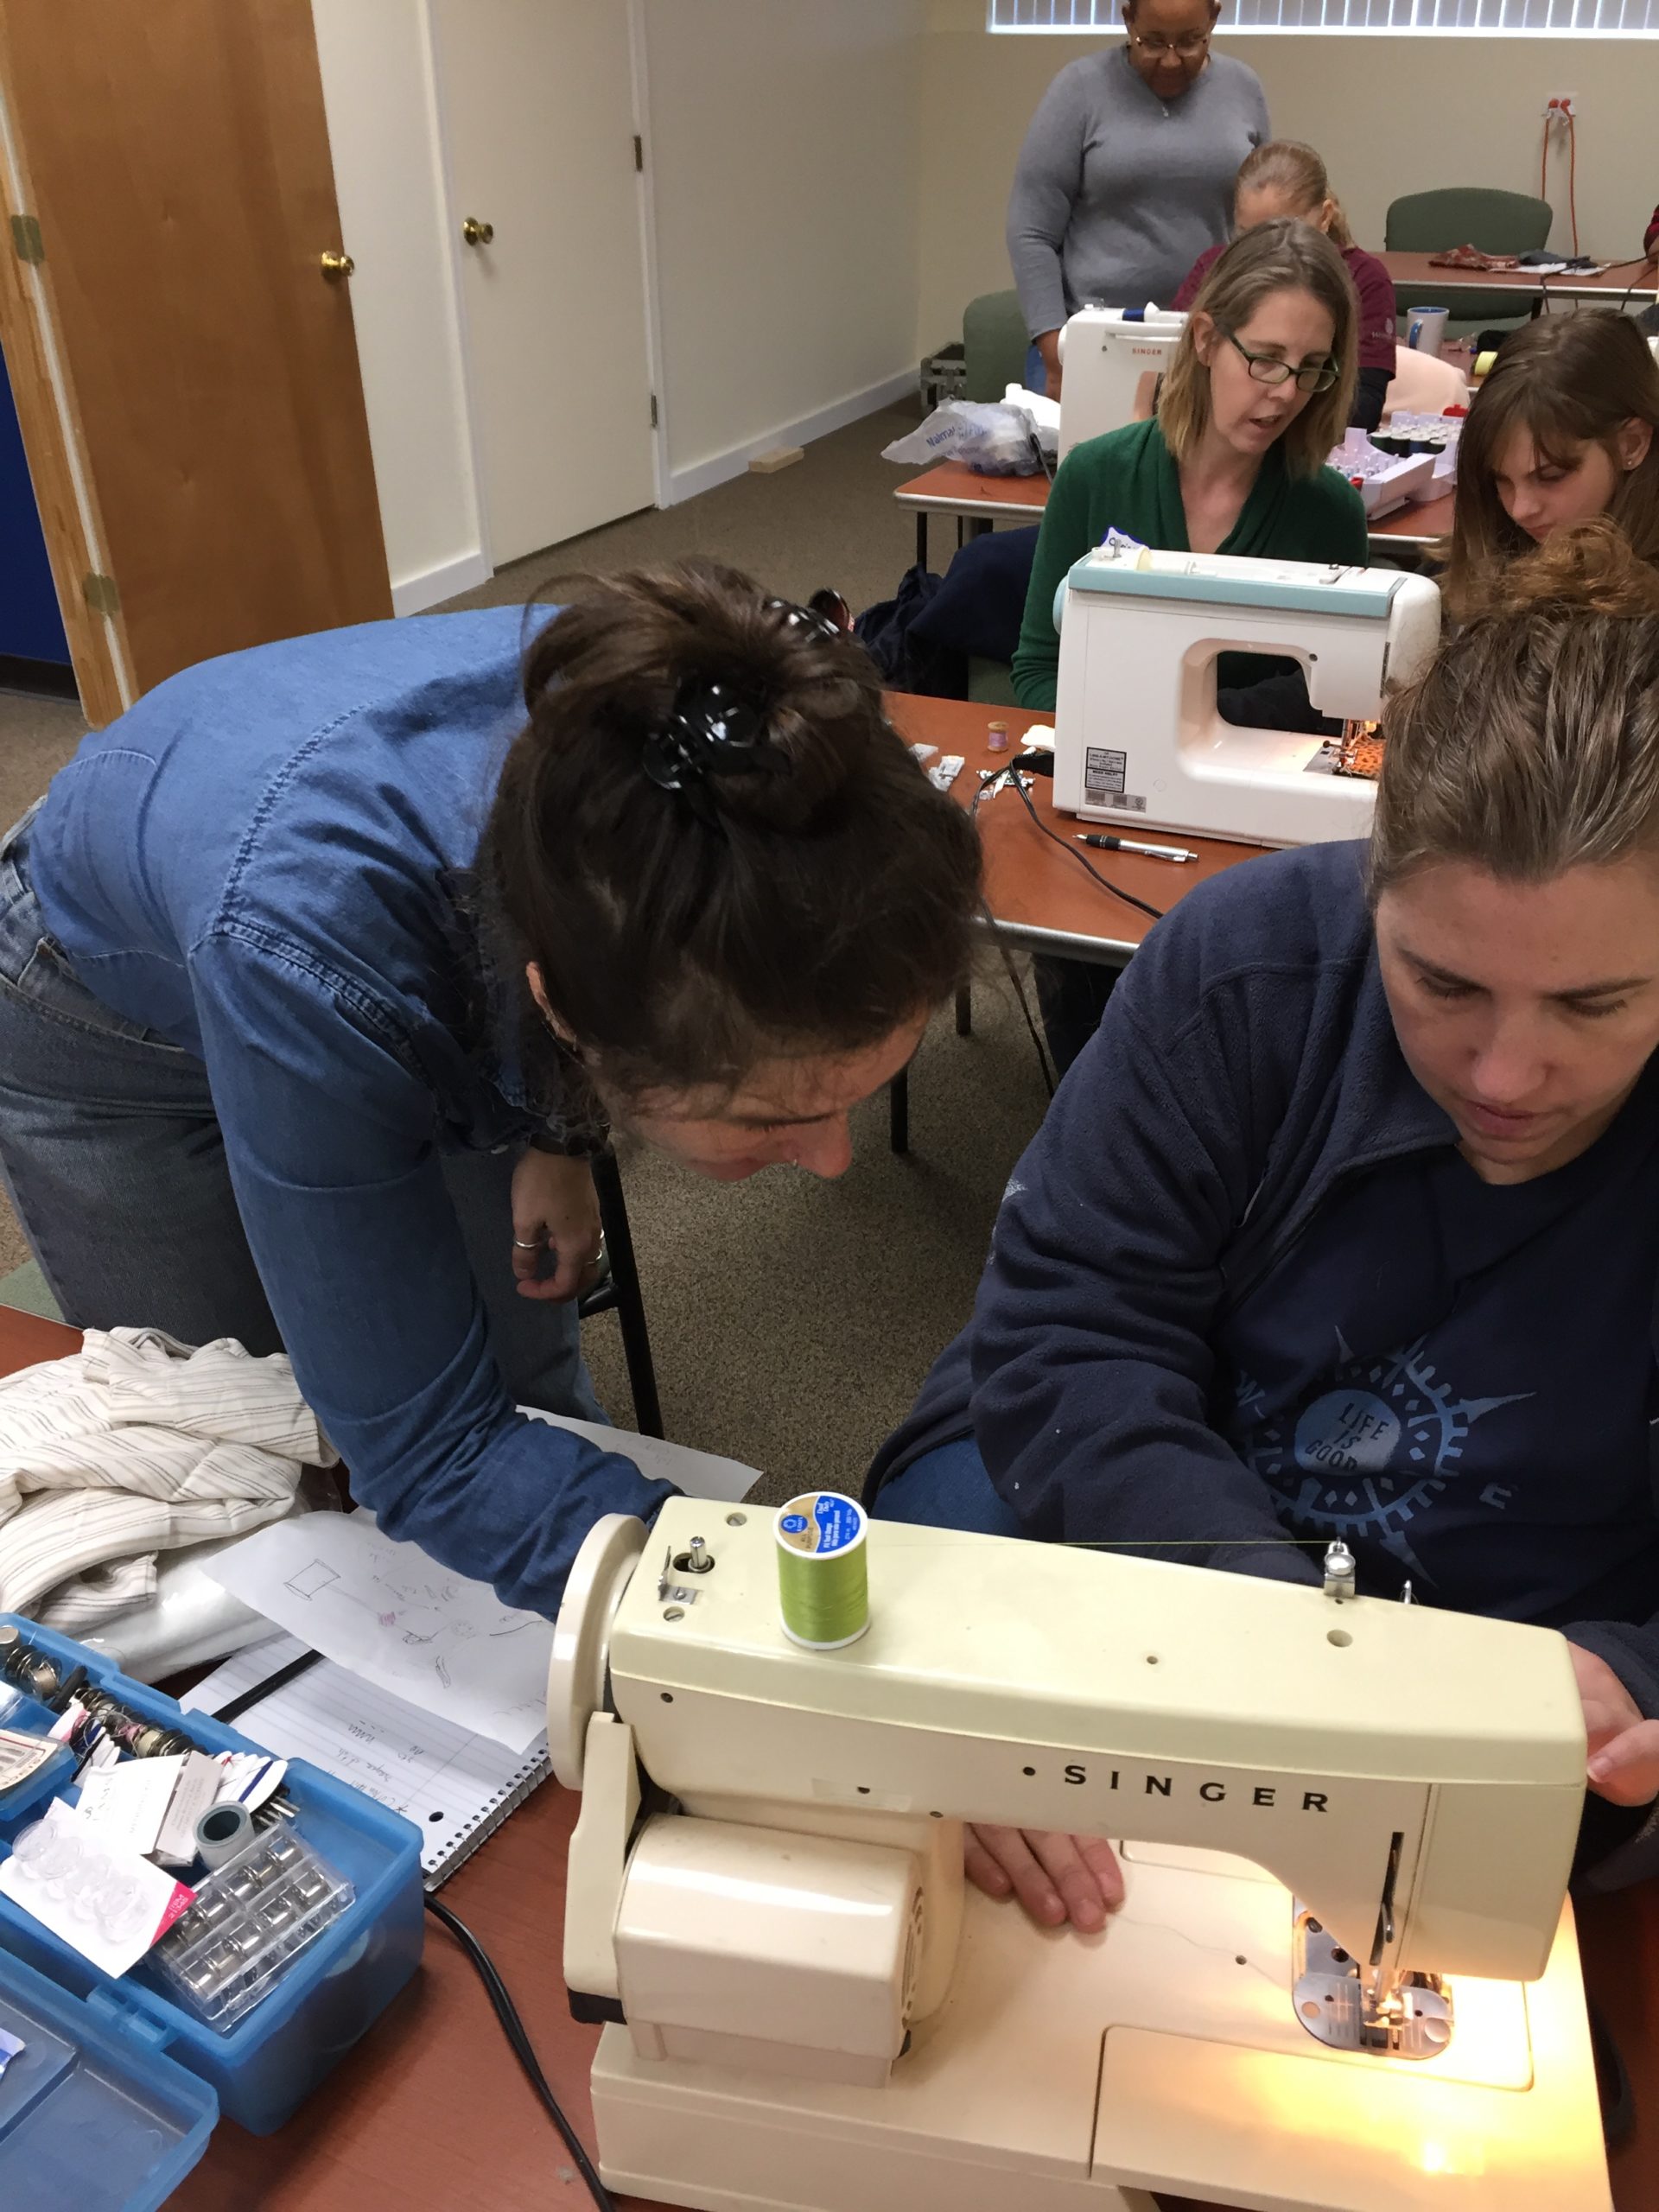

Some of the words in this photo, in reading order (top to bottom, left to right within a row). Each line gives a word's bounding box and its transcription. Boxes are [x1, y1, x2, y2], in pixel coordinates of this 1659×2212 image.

[1338, 1402, 1389, 1440] LIFE
[1305, 1440, 1357, 1469] GOOD
[1333, 1430, 1362, 1450] IS
[1064, 1764, 1329, 1813] SINGER
